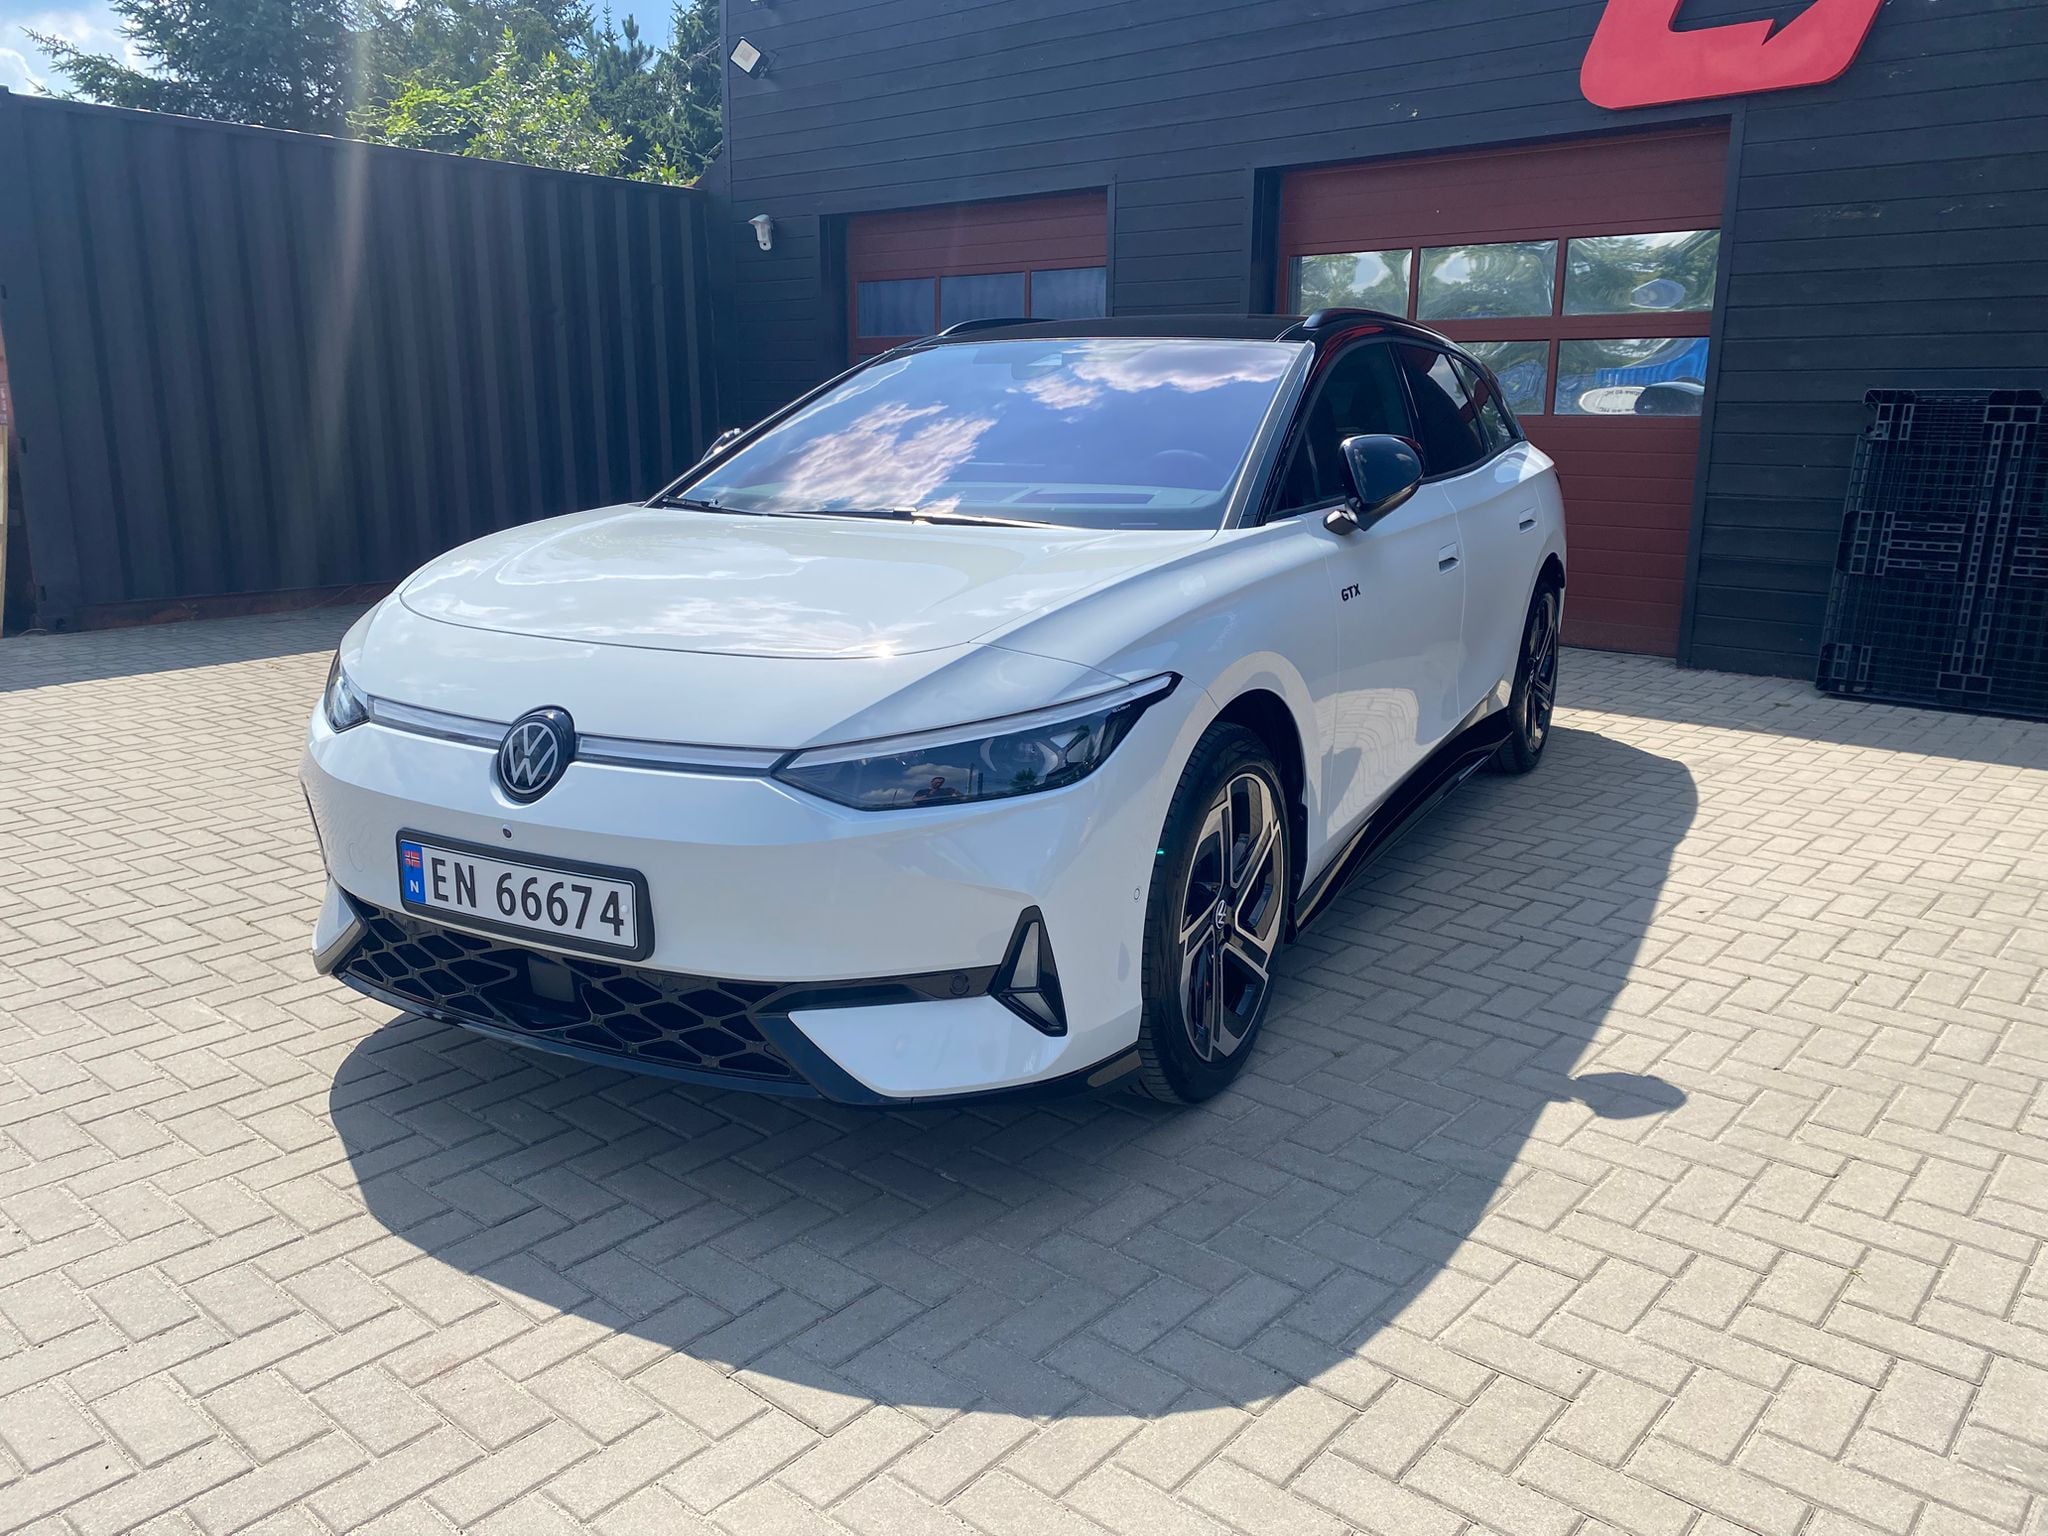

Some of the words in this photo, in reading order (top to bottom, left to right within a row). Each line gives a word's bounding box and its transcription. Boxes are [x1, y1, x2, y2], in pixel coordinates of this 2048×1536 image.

[1341, 583, 1361, 602] GTX
[506, 724, 558, 788] VW
[410, 879, 420, 894] N
[431, 857, 477, 909] EN
[496, 872, 625, 937] 66674
